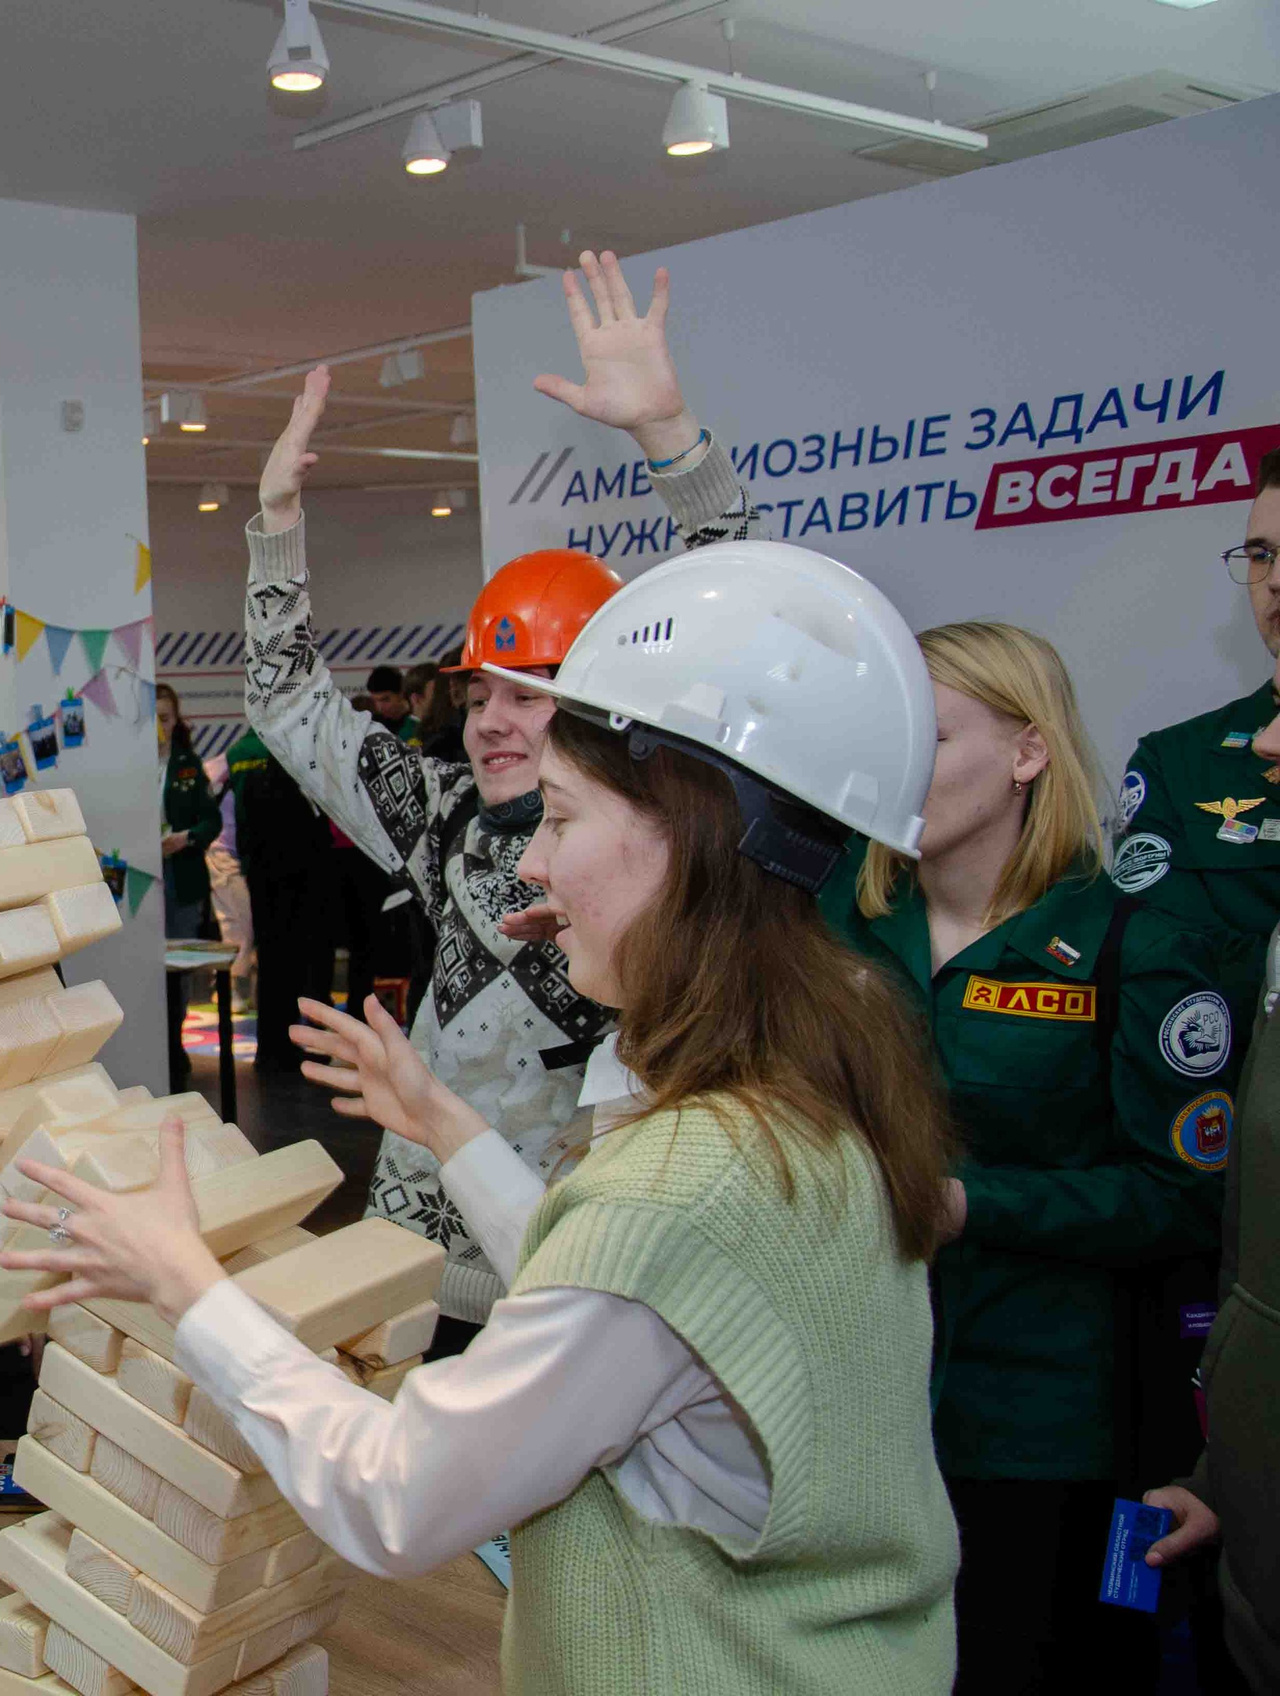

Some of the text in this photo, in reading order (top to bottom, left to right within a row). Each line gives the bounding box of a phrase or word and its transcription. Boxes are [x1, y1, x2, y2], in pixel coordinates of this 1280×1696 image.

[561, 368, 1226, 506] АМБИОЗНЫЕ ЗАДАЧИ
[994, 442, 1251, 516] ВСЕГДА
[1202, 1011, 1220, 1026] РСО
